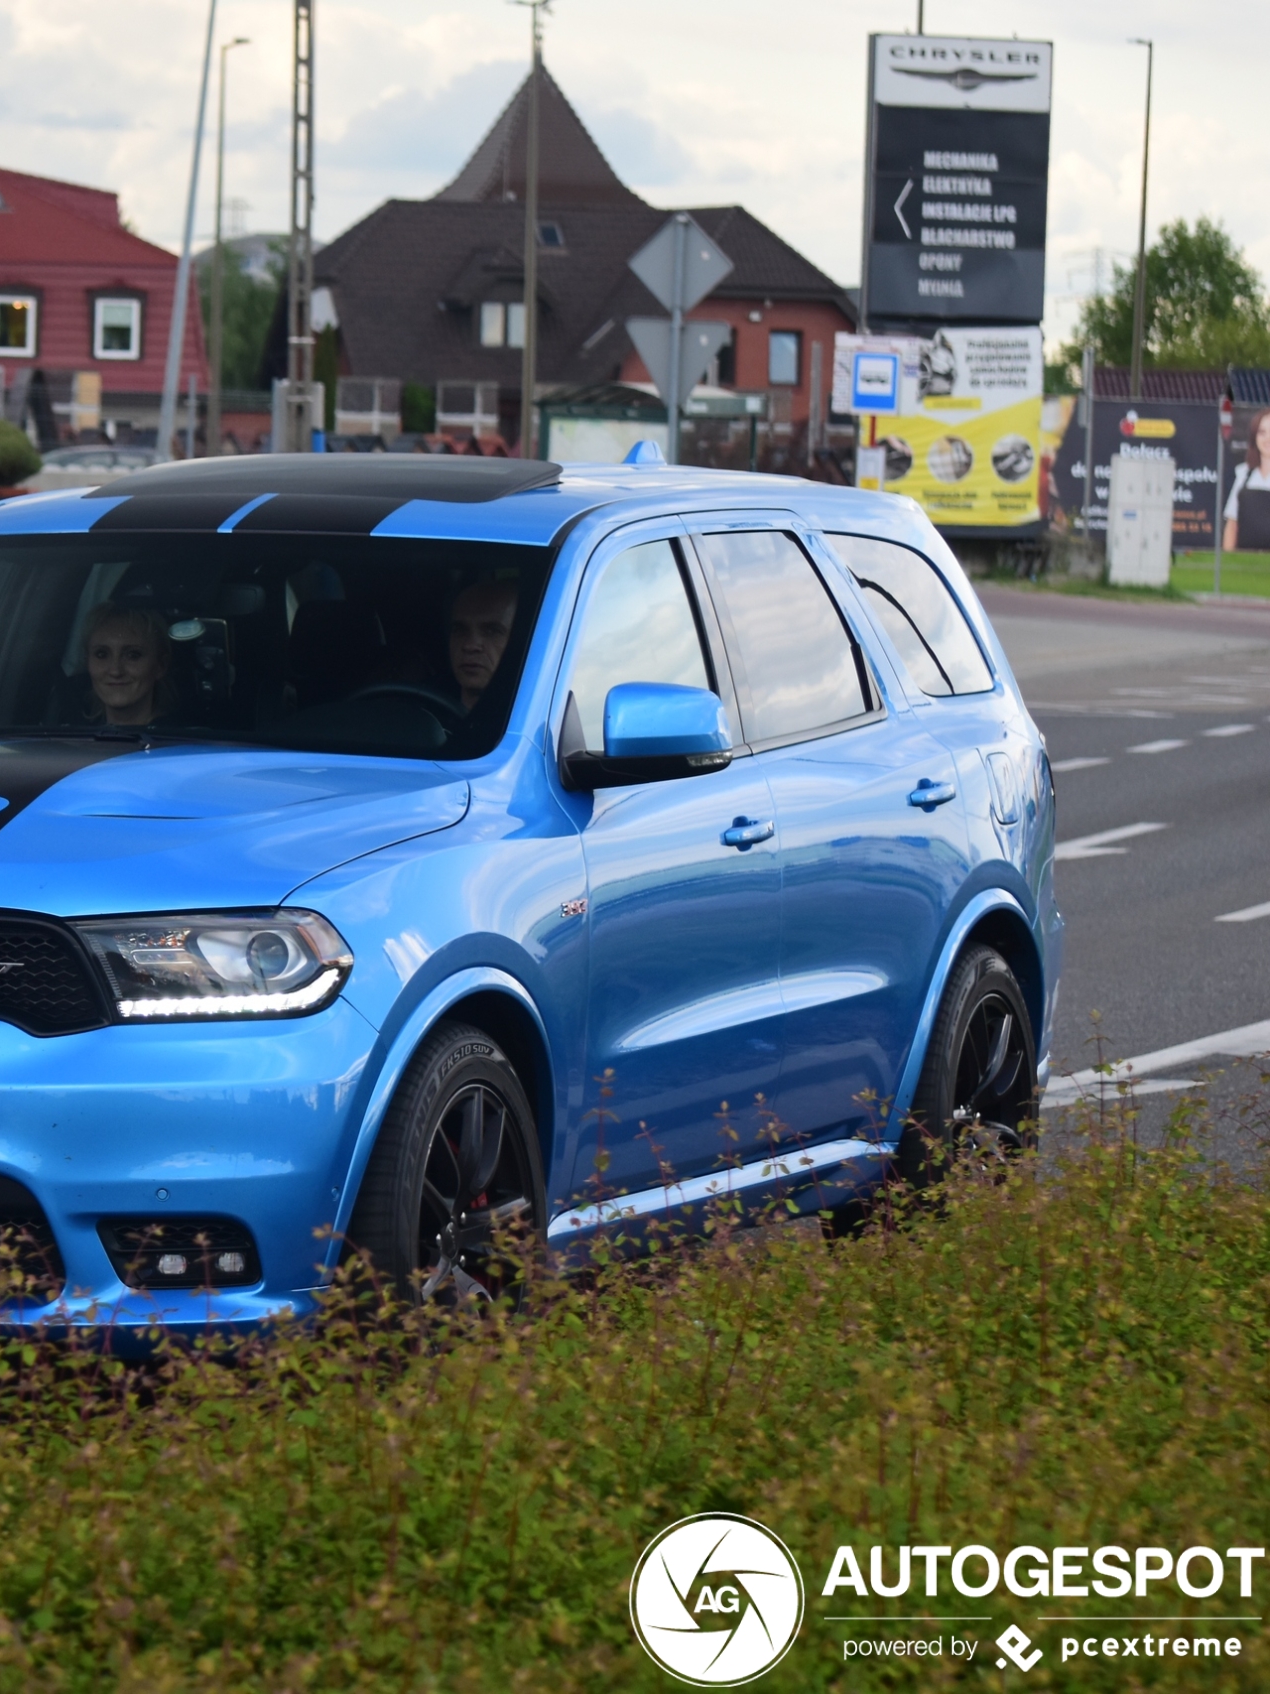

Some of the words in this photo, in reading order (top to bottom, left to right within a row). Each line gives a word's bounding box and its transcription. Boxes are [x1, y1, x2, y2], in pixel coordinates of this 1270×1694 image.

[889, 45, 1041, 65] CHRYSLER
[923, 150, 999, 172] MECHANIKA
[922, 175, 992, 196] ELEKTRYKA
[921, 201, 992, 222] INSTALACJE
[993, 204, 1017, 223] LPG
[918, 252, 963, 272] OPONY
[917, 278, 964, 298] MYJNIA
[441, 1046, 472, 1077] FK510
[473, 1044, 490, 1054] SUV
